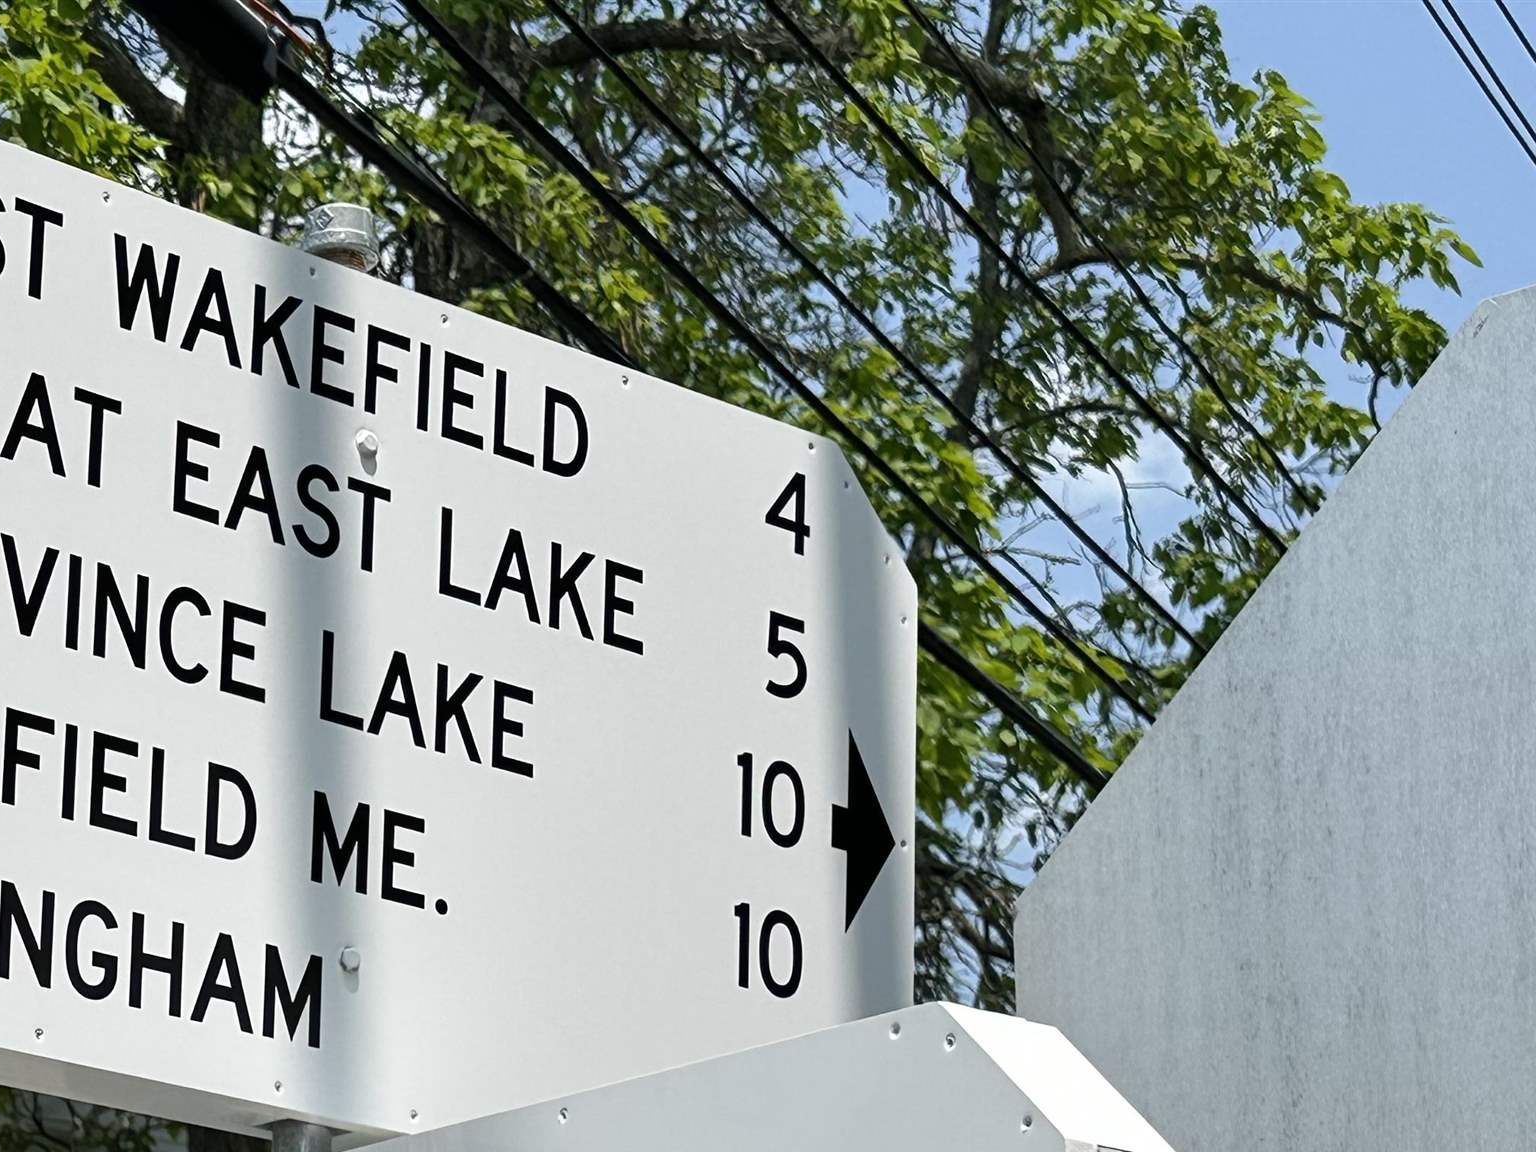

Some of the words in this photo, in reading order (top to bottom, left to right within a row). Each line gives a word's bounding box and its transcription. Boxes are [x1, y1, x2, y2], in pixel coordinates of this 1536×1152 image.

[113, 232, 589, 478] WAKEFIELD
[765, 472, 811, 556] 4
[172, 420, 392, 573] EAST
[438, 506, 644, 656] LAKE
[765, 610, 808, 699] 5
[319, 629, 534, 779] LAKE
[737, 752, 805, 849] 10
[310, 790, 451, 916] ME.
[734, 902, 803, 999] 10
